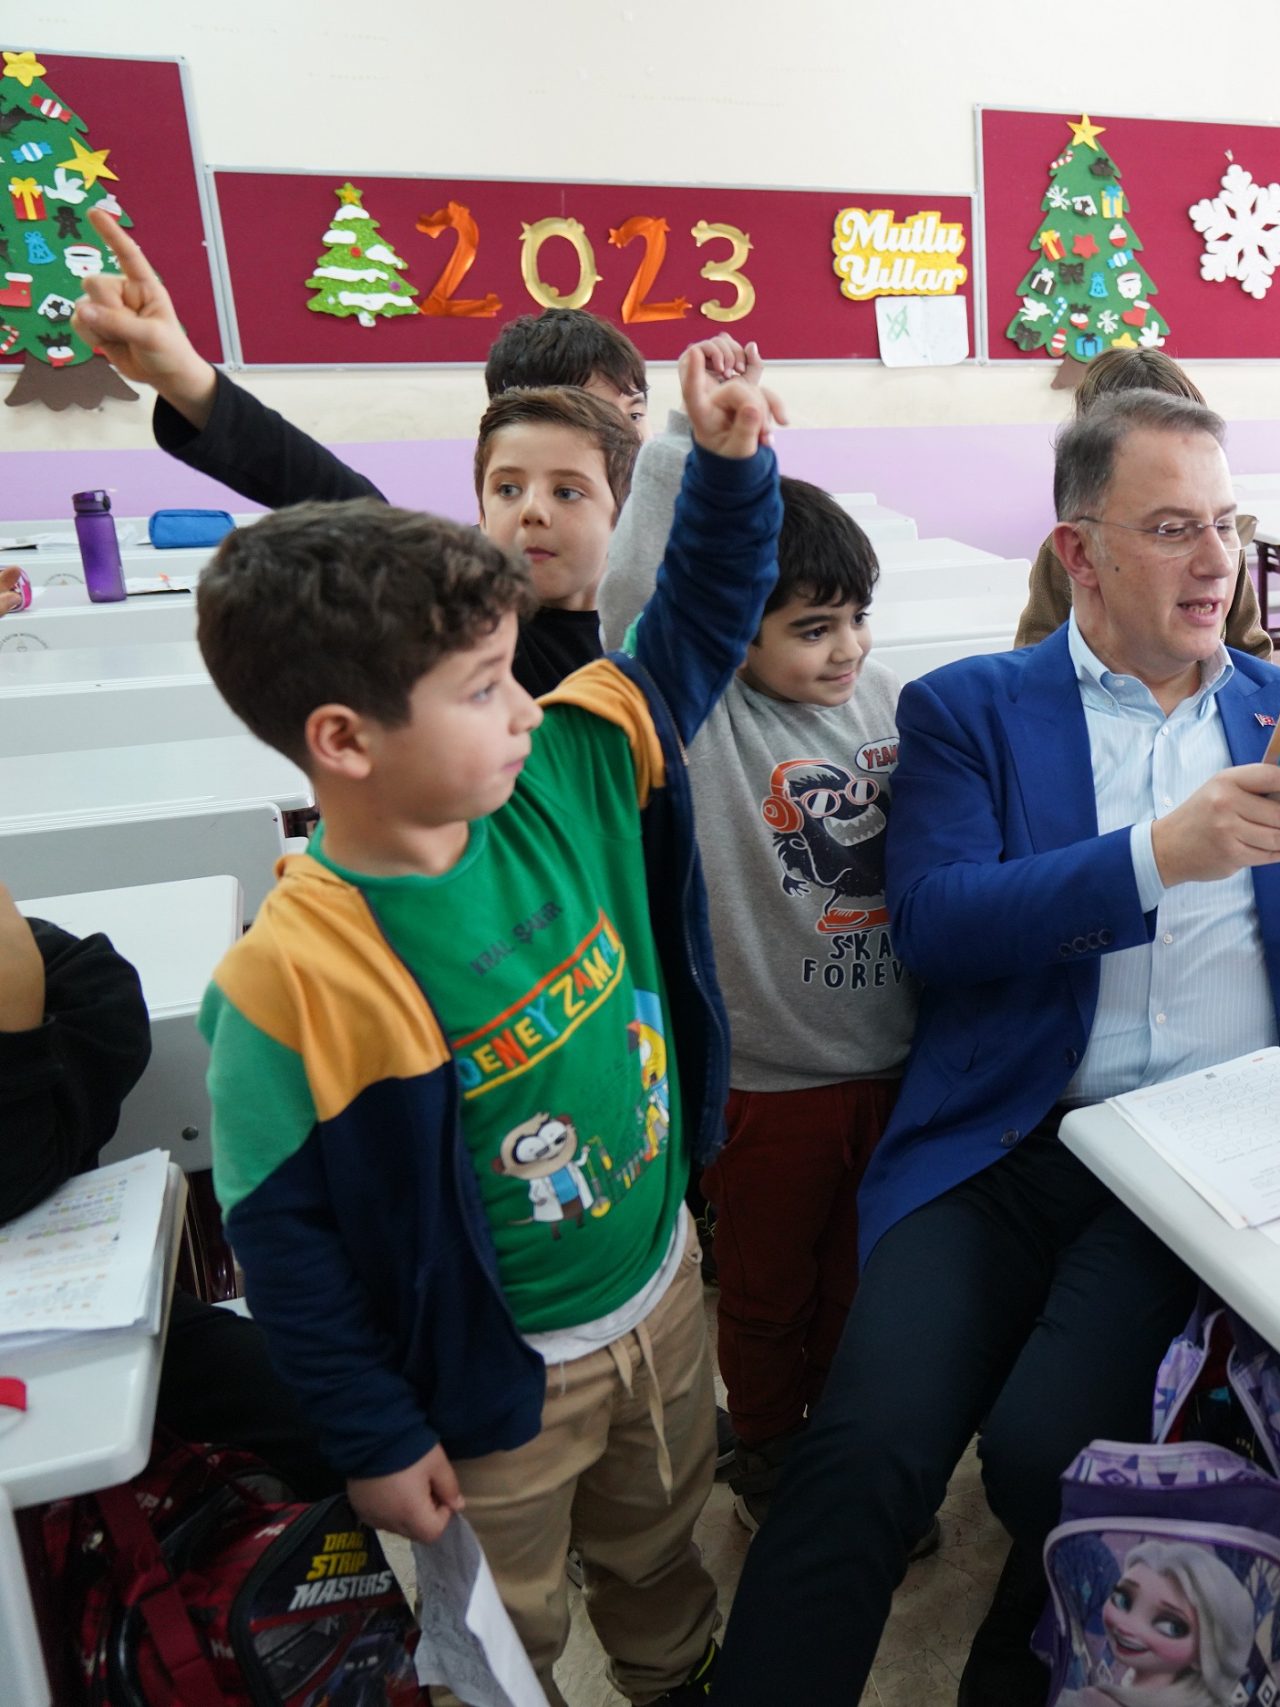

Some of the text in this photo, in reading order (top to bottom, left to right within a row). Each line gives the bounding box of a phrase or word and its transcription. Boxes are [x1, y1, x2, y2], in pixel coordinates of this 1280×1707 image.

[839, 210, 963, 255] Mutlu
[415, 200, 756, 324] 2023
[838, 253, 965, 296] Yıllar
[829, 930, 893, 961] SKA
[802, 957, 904, 990] FOREV
[457, 996, 559, 1089] DENEY
[305, 1550, 368, 1582] STRIP
[287, 1569, 394, 1612] MASTERS
